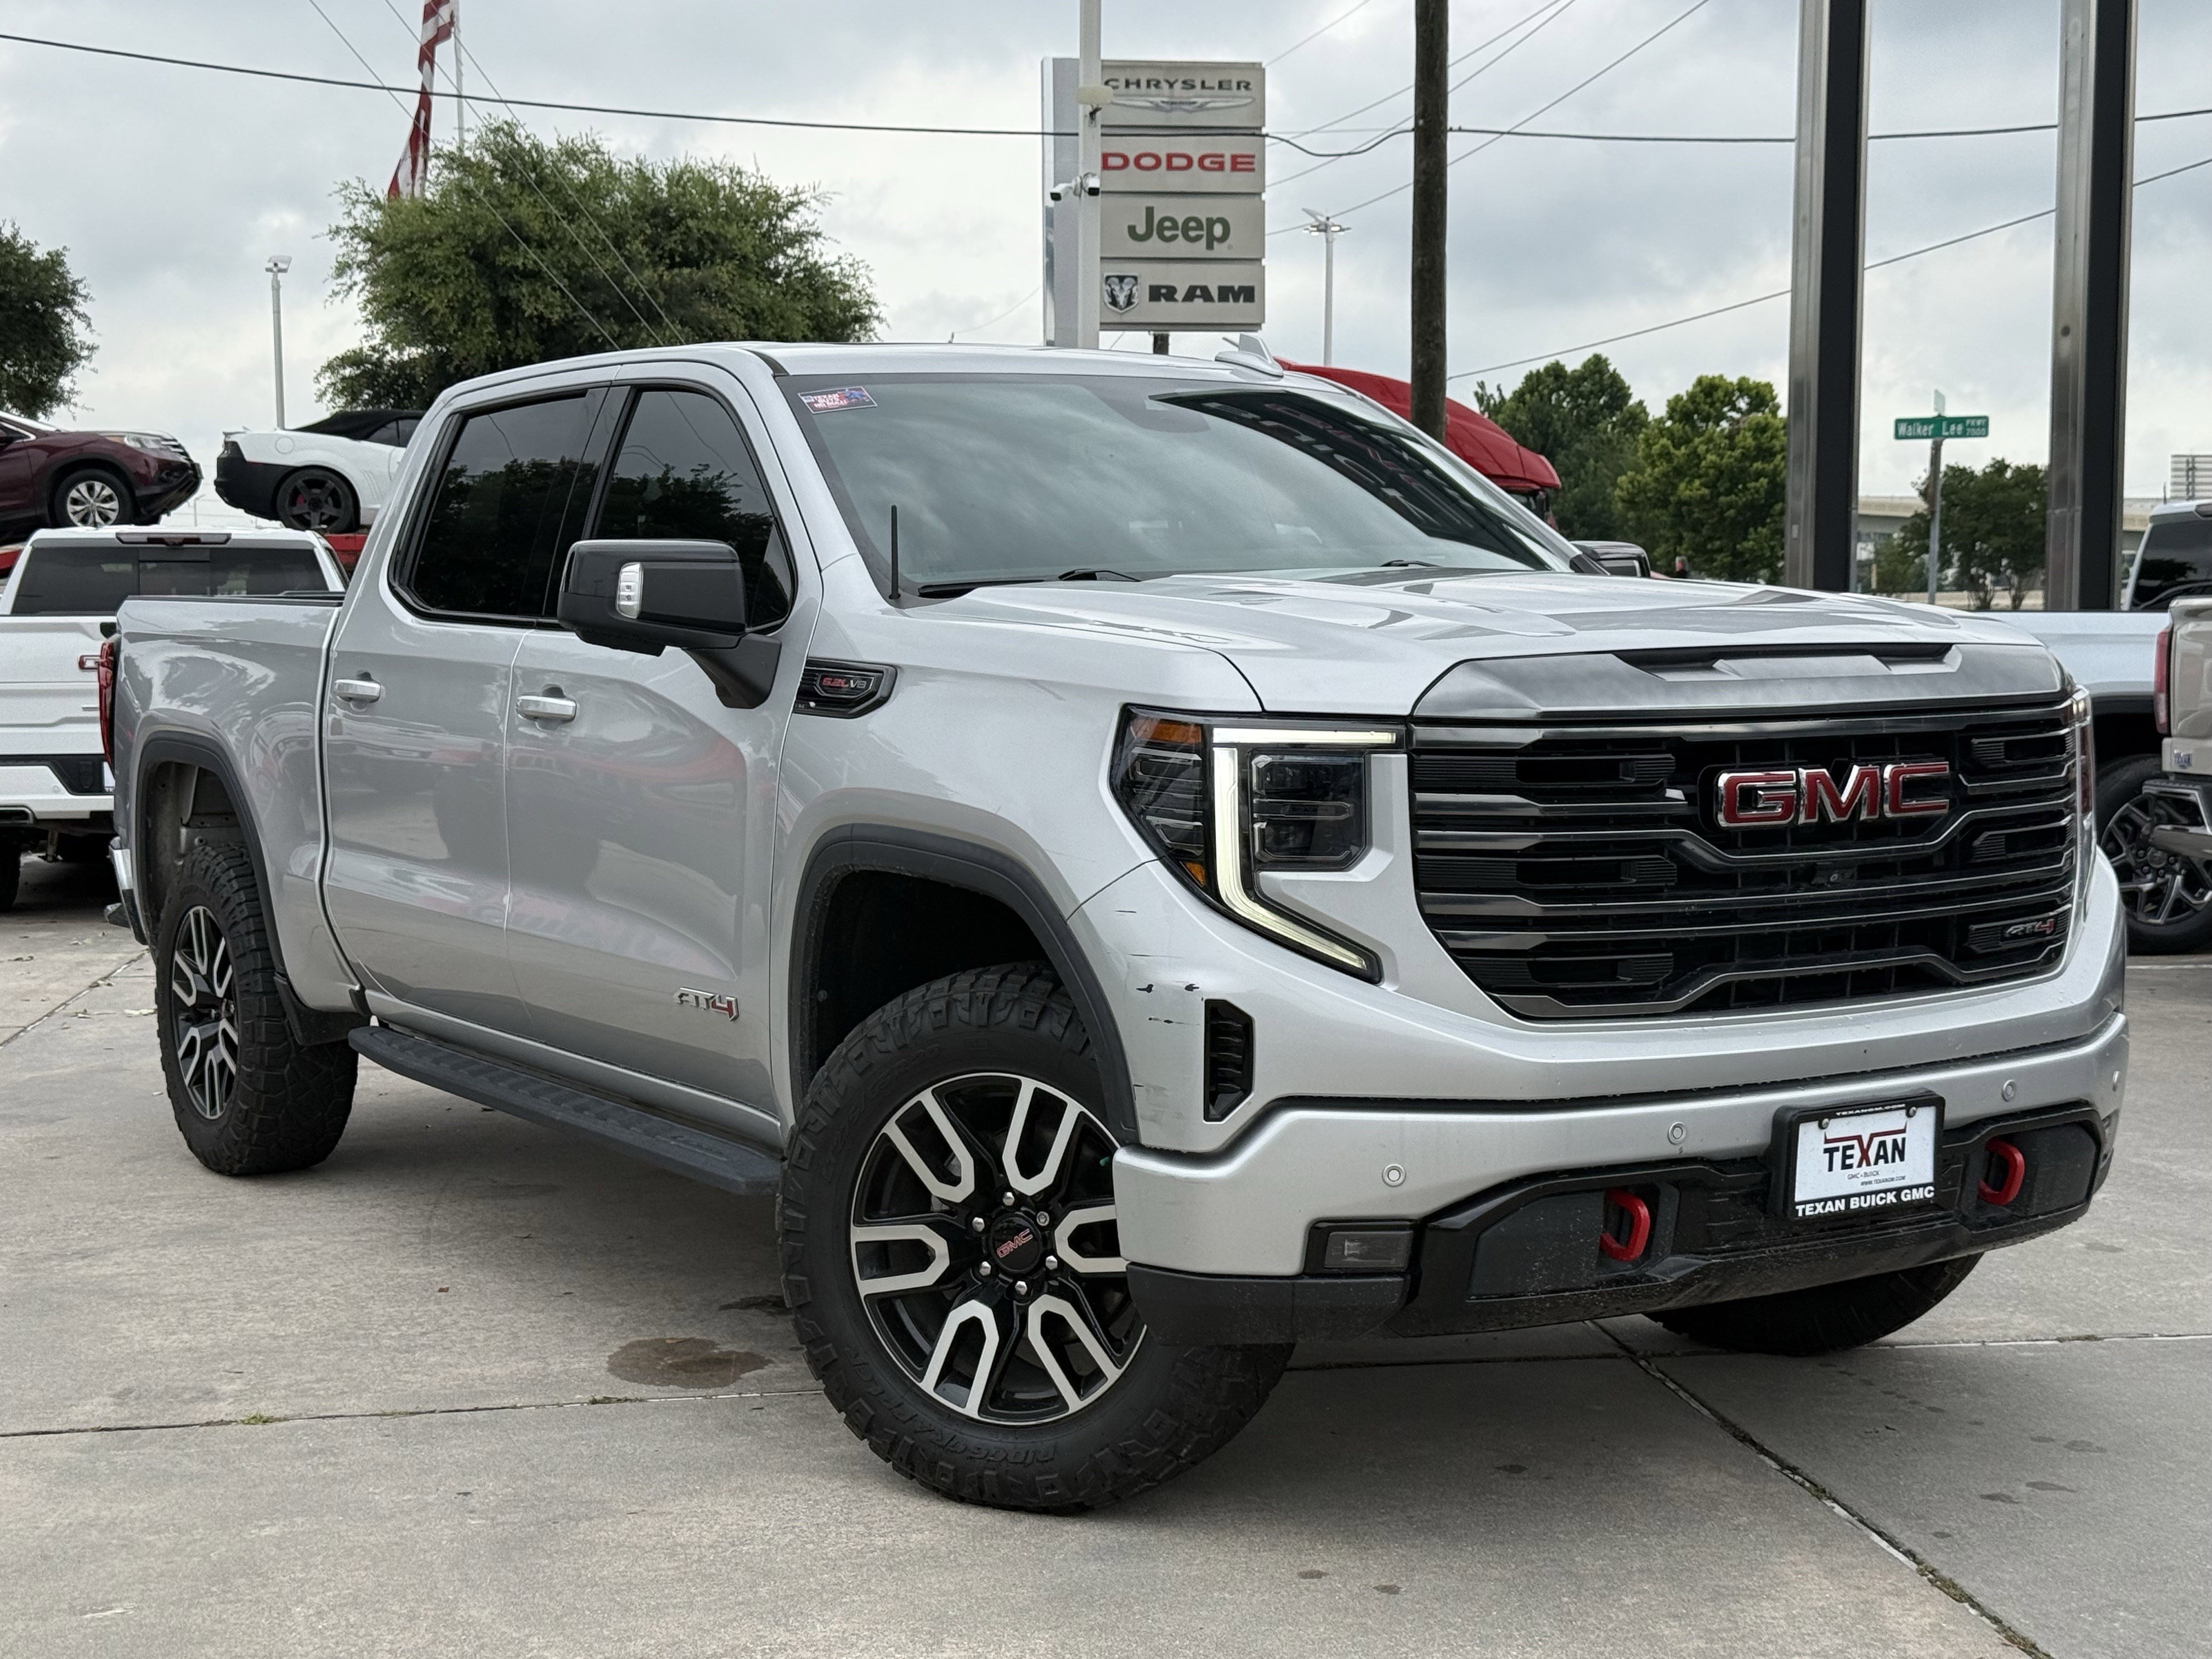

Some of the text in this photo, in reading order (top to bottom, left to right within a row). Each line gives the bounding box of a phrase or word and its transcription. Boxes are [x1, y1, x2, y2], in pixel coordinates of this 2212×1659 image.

[1103, 78, 1251, 91] CHRYSLER
[1102, 152, 1255, 172] DODGE
[1127, 206, 1231, 251] Jeep
[1148, 284, 1256, 303] RAM
[1897, 421, 1934, 437] Walker
[1942, 420, 1963, 436] Lee
[850, 680, 867, 689] V8
[1717, 761, 1950, 828] GMC
[1835, 1103, 1906, 1116] TEXANGM.COM
[1823, 1130, 1906, 1172] TEXAN
[1795, 1186, 1935, 1217] TEXAN BUICK GMC
[997, 1228, 1033, 1258] GMC
